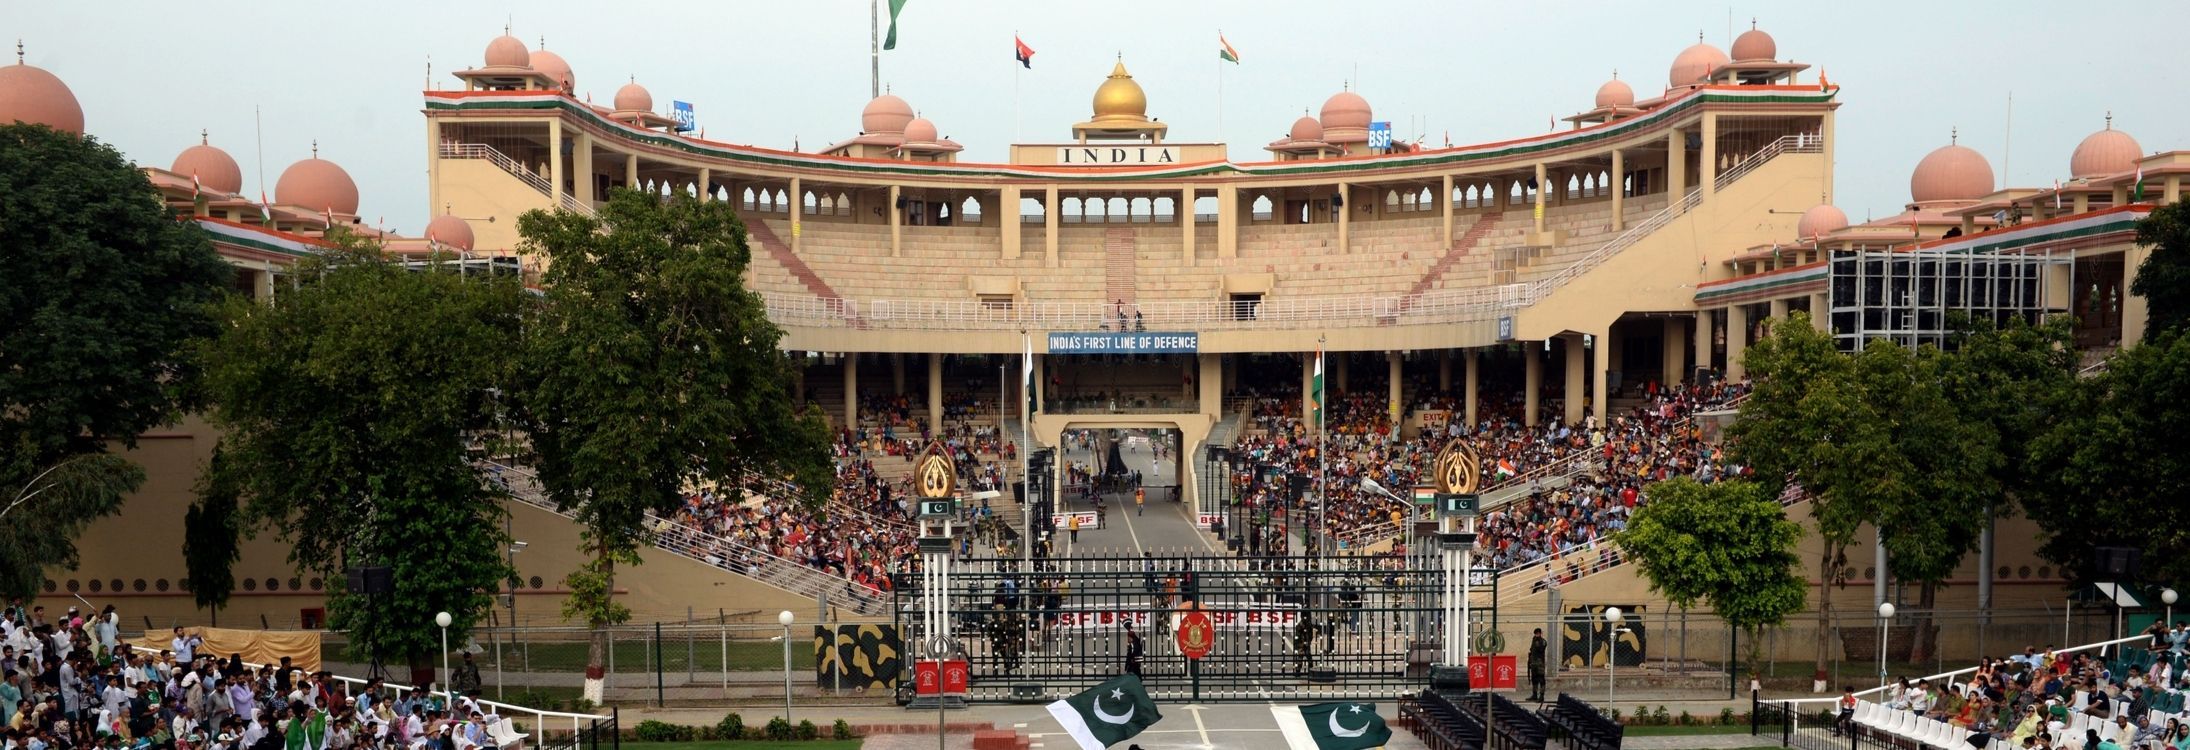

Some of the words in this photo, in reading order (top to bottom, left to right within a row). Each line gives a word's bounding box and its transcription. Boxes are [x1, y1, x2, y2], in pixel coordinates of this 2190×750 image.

[676, 109, 694, 128] BSF
[1368, 130, 1390, 147] BSF
[1063, 148, 1173, 163] INDIA
[1050, 336, 1081, 350] INDIA'S
[1083, 336, 1112, 350] FIRST
[1114, 336, 1136, 349] LINE
[1139, 336, 1152, 349] OF
[1154, 336, 1197, 349] DEFENCE
[1423, 413, 1442, 421] EXIT
[1248, 610, 1295, 624] BSF
